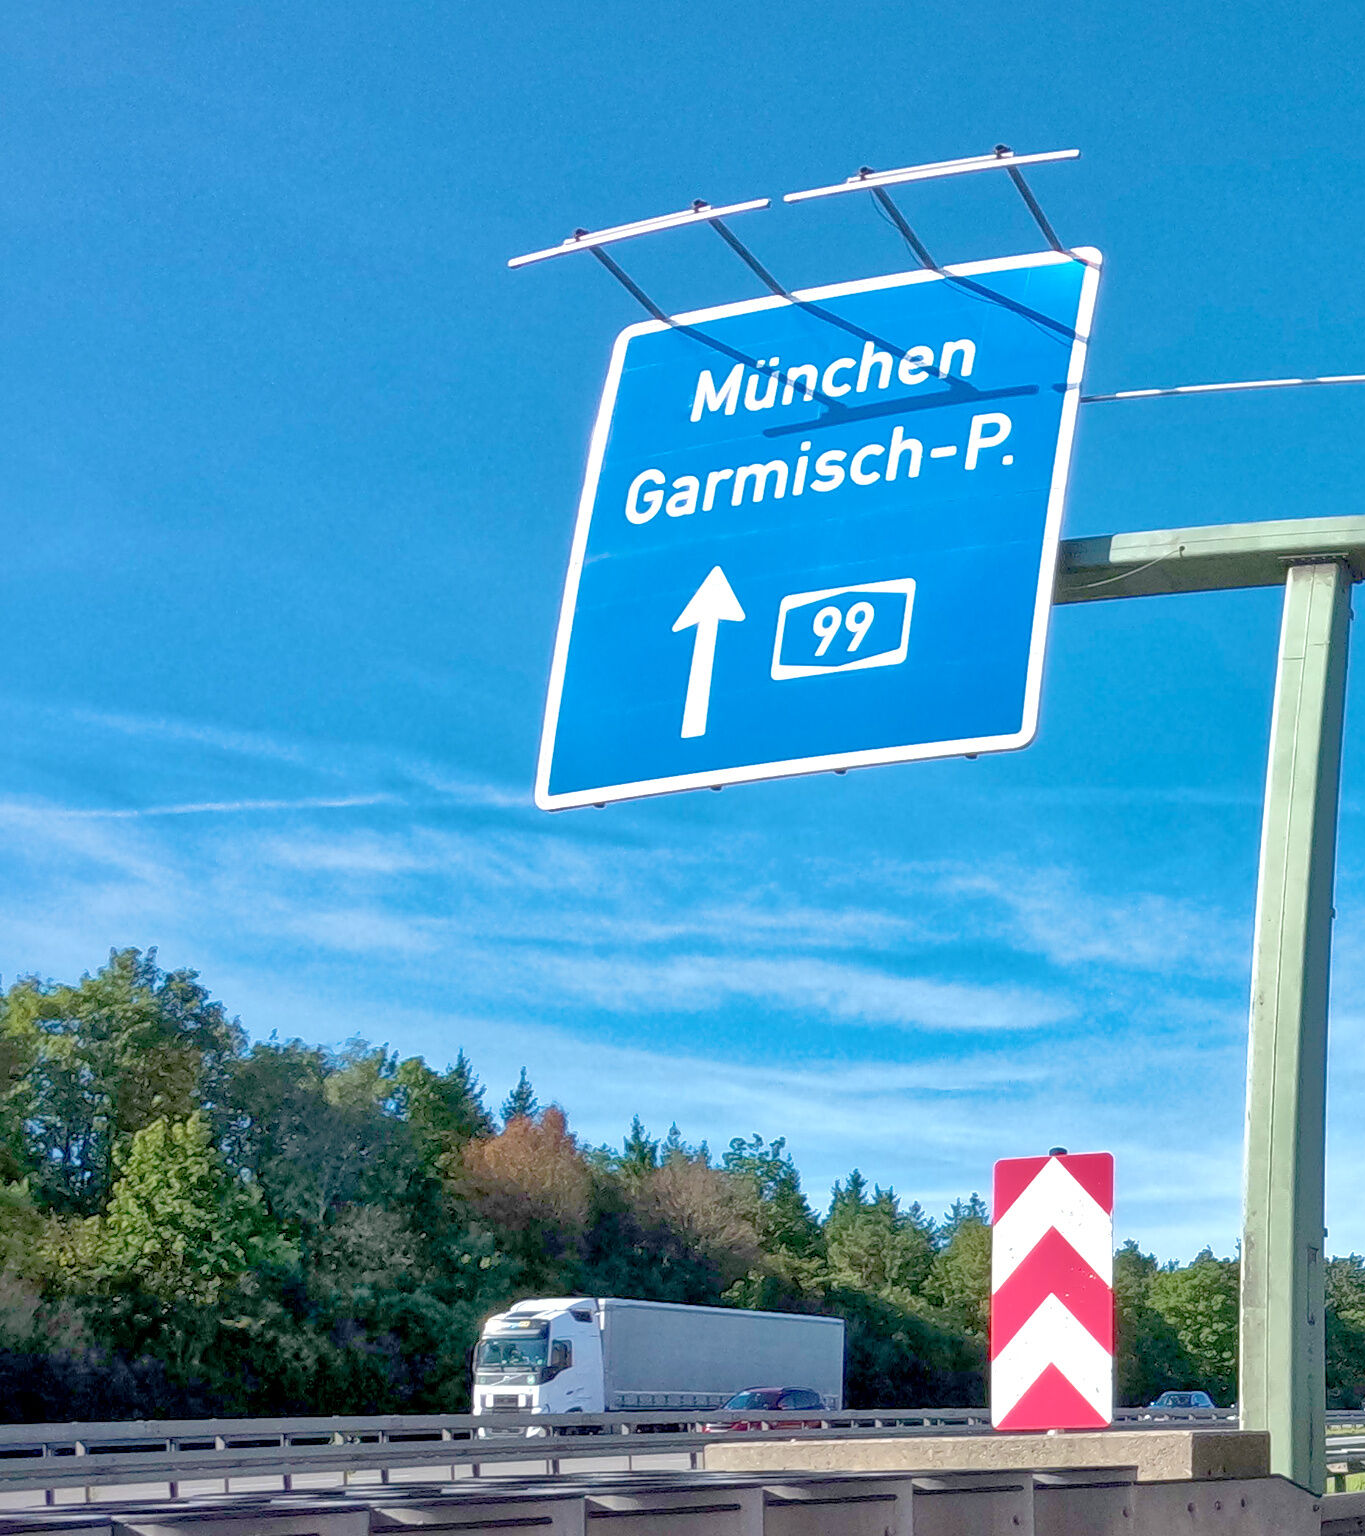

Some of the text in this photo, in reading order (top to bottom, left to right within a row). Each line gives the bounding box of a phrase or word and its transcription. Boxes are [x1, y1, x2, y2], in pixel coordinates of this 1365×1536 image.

[689, 338, 976, 423] München
[624, 412, 1016, 525] Garmisch-P.
[811, 600, 876, 656] 99
